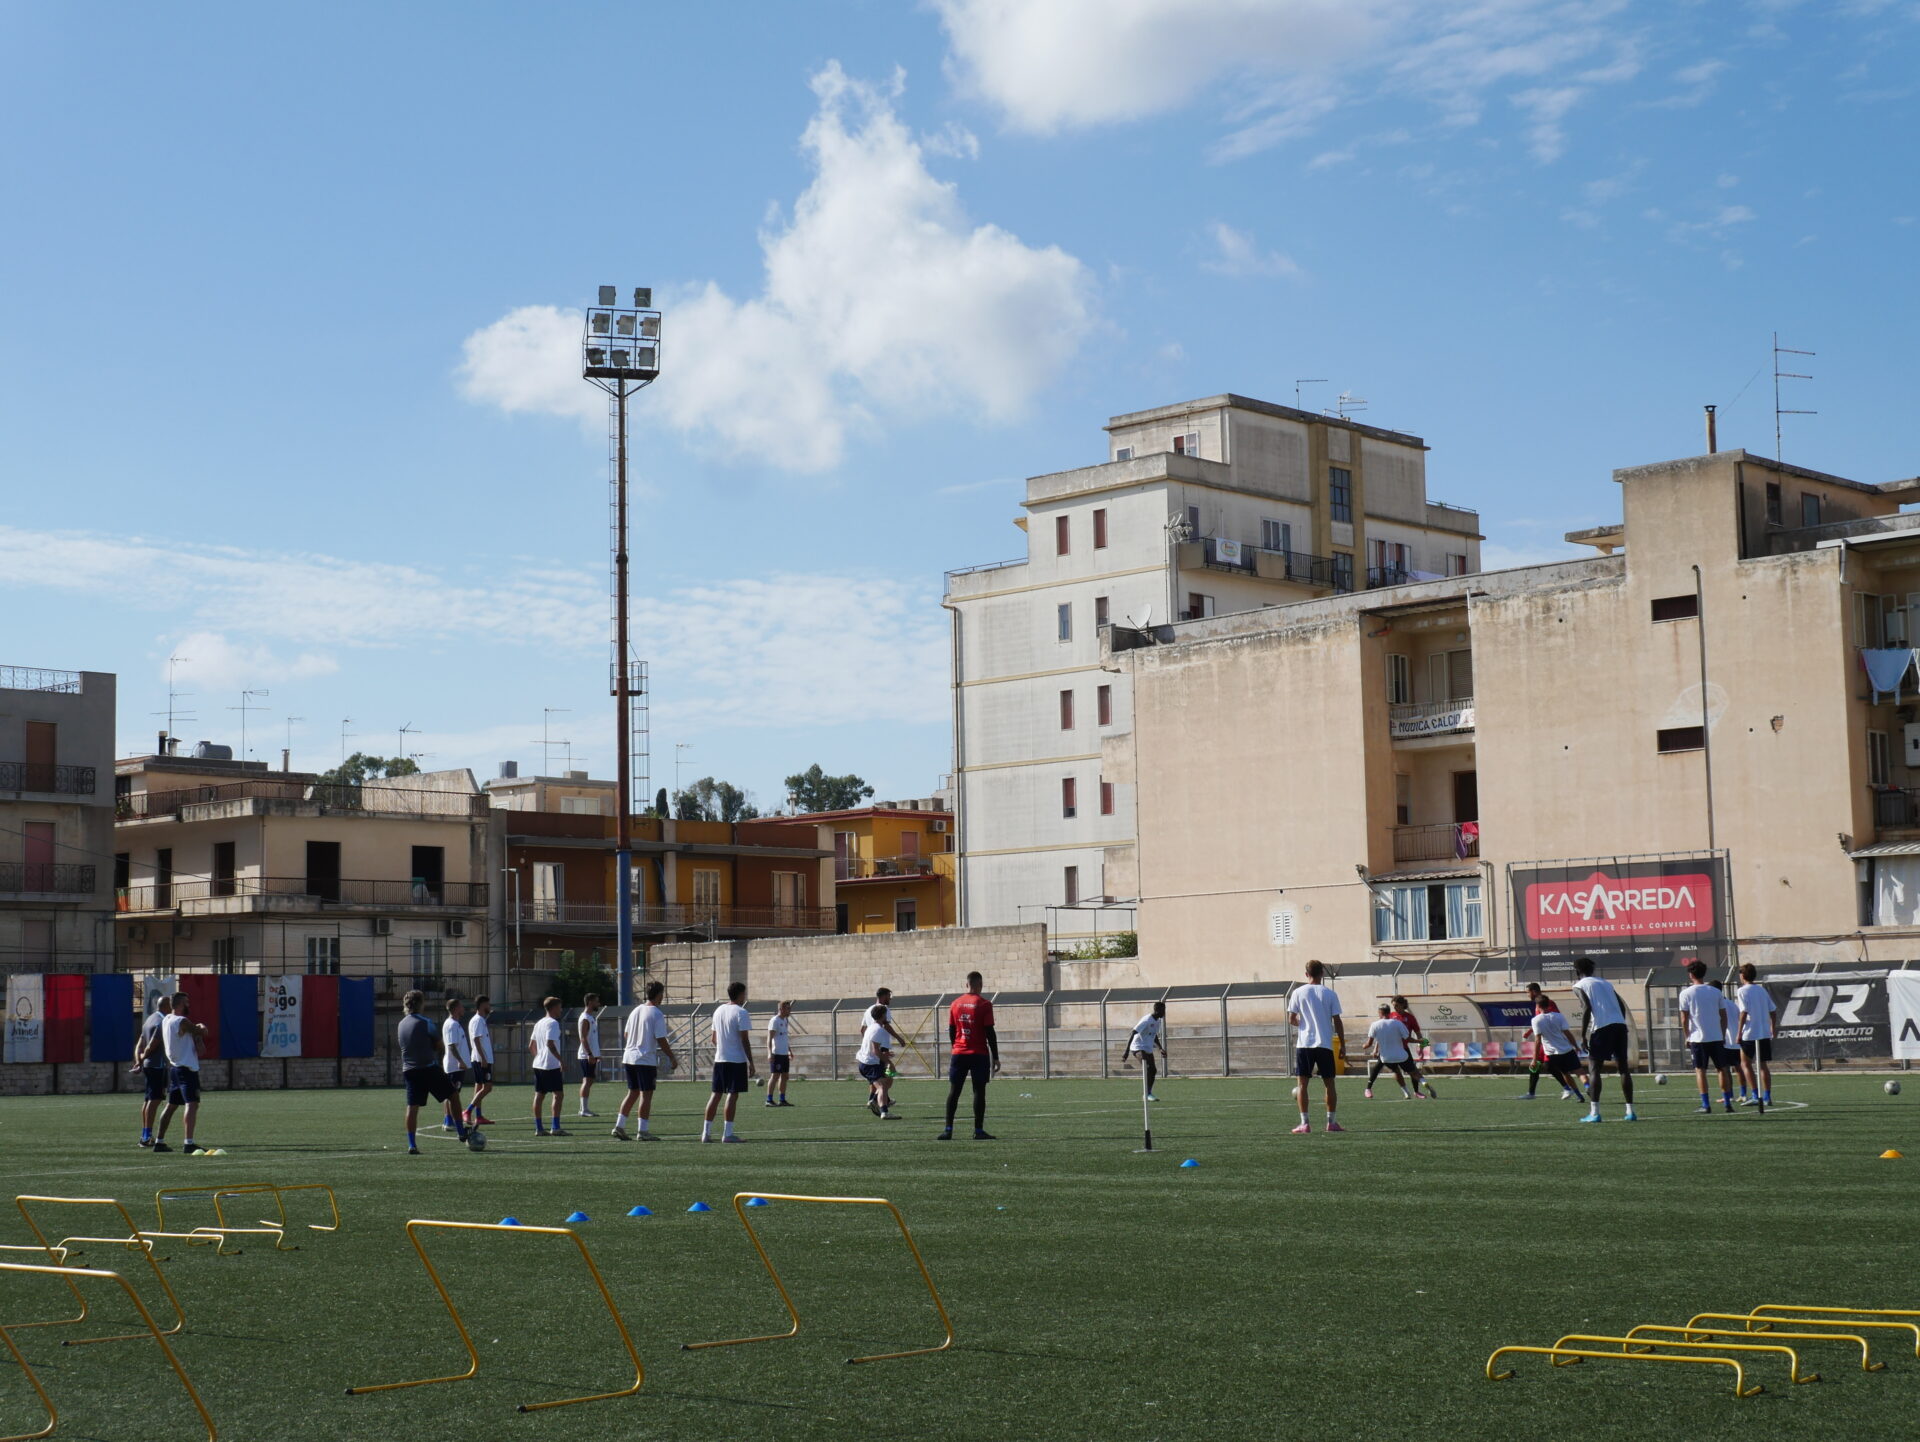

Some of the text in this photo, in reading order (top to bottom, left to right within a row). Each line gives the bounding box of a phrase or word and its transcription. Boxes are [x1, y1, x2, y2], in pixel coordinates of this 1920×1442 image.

[1398, 721, 1430, 733] MODICA
[1431, 713, 1461, 729] CALCIO
[1540, 884, 1695, 920] KASARREDA
[1569, 924, 1615, 932] ARREDARE
[1649, 920, 1697, 929] CONVIENE
[1502, 1007, 1532, 1017] OSPITI
[1780, 983, 1869, 1026] DR
